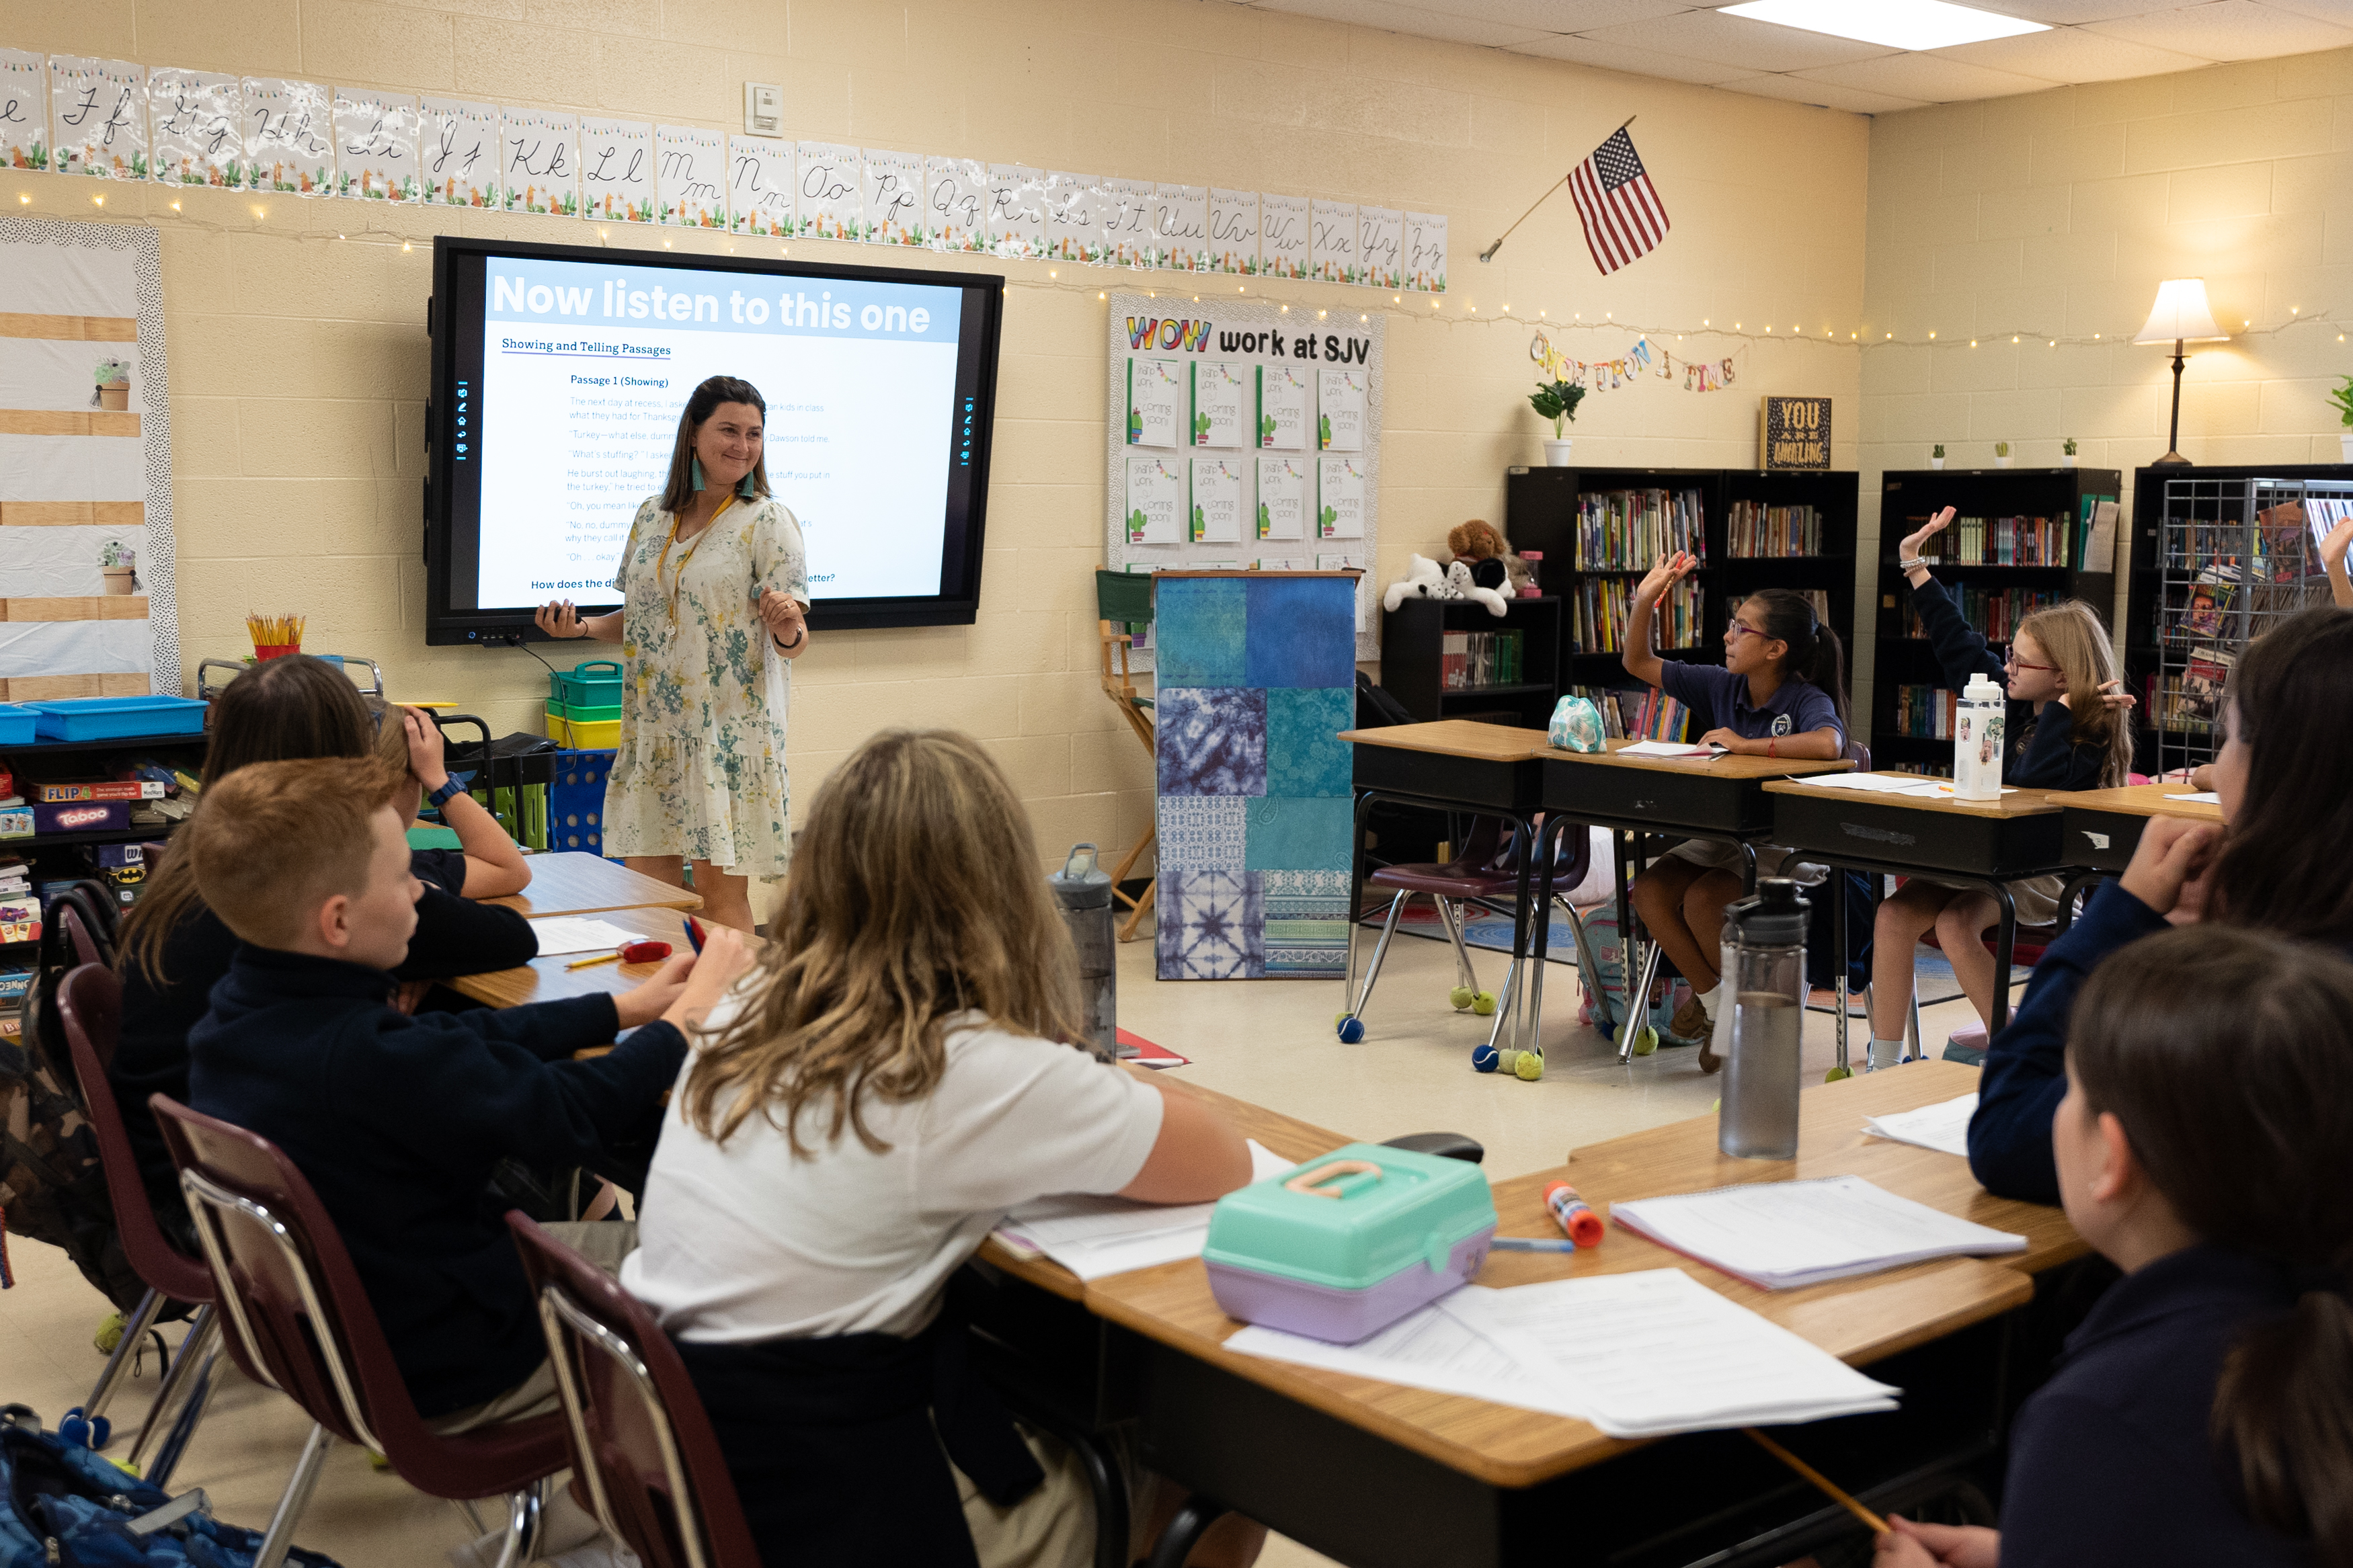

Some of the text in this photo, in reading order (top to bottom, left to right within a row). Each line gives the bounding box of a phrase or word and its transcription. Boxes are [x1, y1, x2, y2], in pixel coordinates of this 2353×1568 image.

[493, 275, 930, 333] Now listen to this one
[1126, 316, 1369, 364] WOW work at SJV
[502, 338, 671, 357] Showing and Telling Passages
[1531, 333, 1735, 392] ONCE UPON A TIME
[571, 375, 669, 388] Passage 1 (Showing)
[570, 397, 586, 406] The
[588, 398, 606, 406] next
[608, 398, 623, 409] day
[625, 399, 633, 407] at
[635, 400, 664, 409] recess,
[669, 401, 688, 409] aske
[780, 403, 795, 411] kids
[797, 403, 803, 411] in
[805, 404, 824, 412] class
[569, 411, 680, 423] what they had for Thanksgi
[1782, 401, 1819, 429] YOU
[651, 431, 678, 440] dumm
[770, 434, 799, 442] Dawson
[1781, 431, 1818, 440] ARE
[1773, 442, 1823, 464] AMAZING
[567, 469, 579, 477] He
[582, 470, 602, 478] burst
[605, 470, 619, 478] out
[621, 470, 657, 479] laughing,
[776, 470, 793, 479] stuff
[795, 472, 808, 480] you
[809, 472, 822, 480] put
[567, 483, 580, 491] the
[627, 483, 645, 491] tried
[586, 503, 601, 511] you
[565, 534, 582, 544] why
[584, 535, 602, 544] they
[808, 573, 835, 582] etter?
[531, 581, 555, 589] How
[557, 579, 583, 589] does
[586, 579, 602, 587] the
[48, 786, 91, 800] FLIP 4
[60, 809, 107, 825] Taboo
